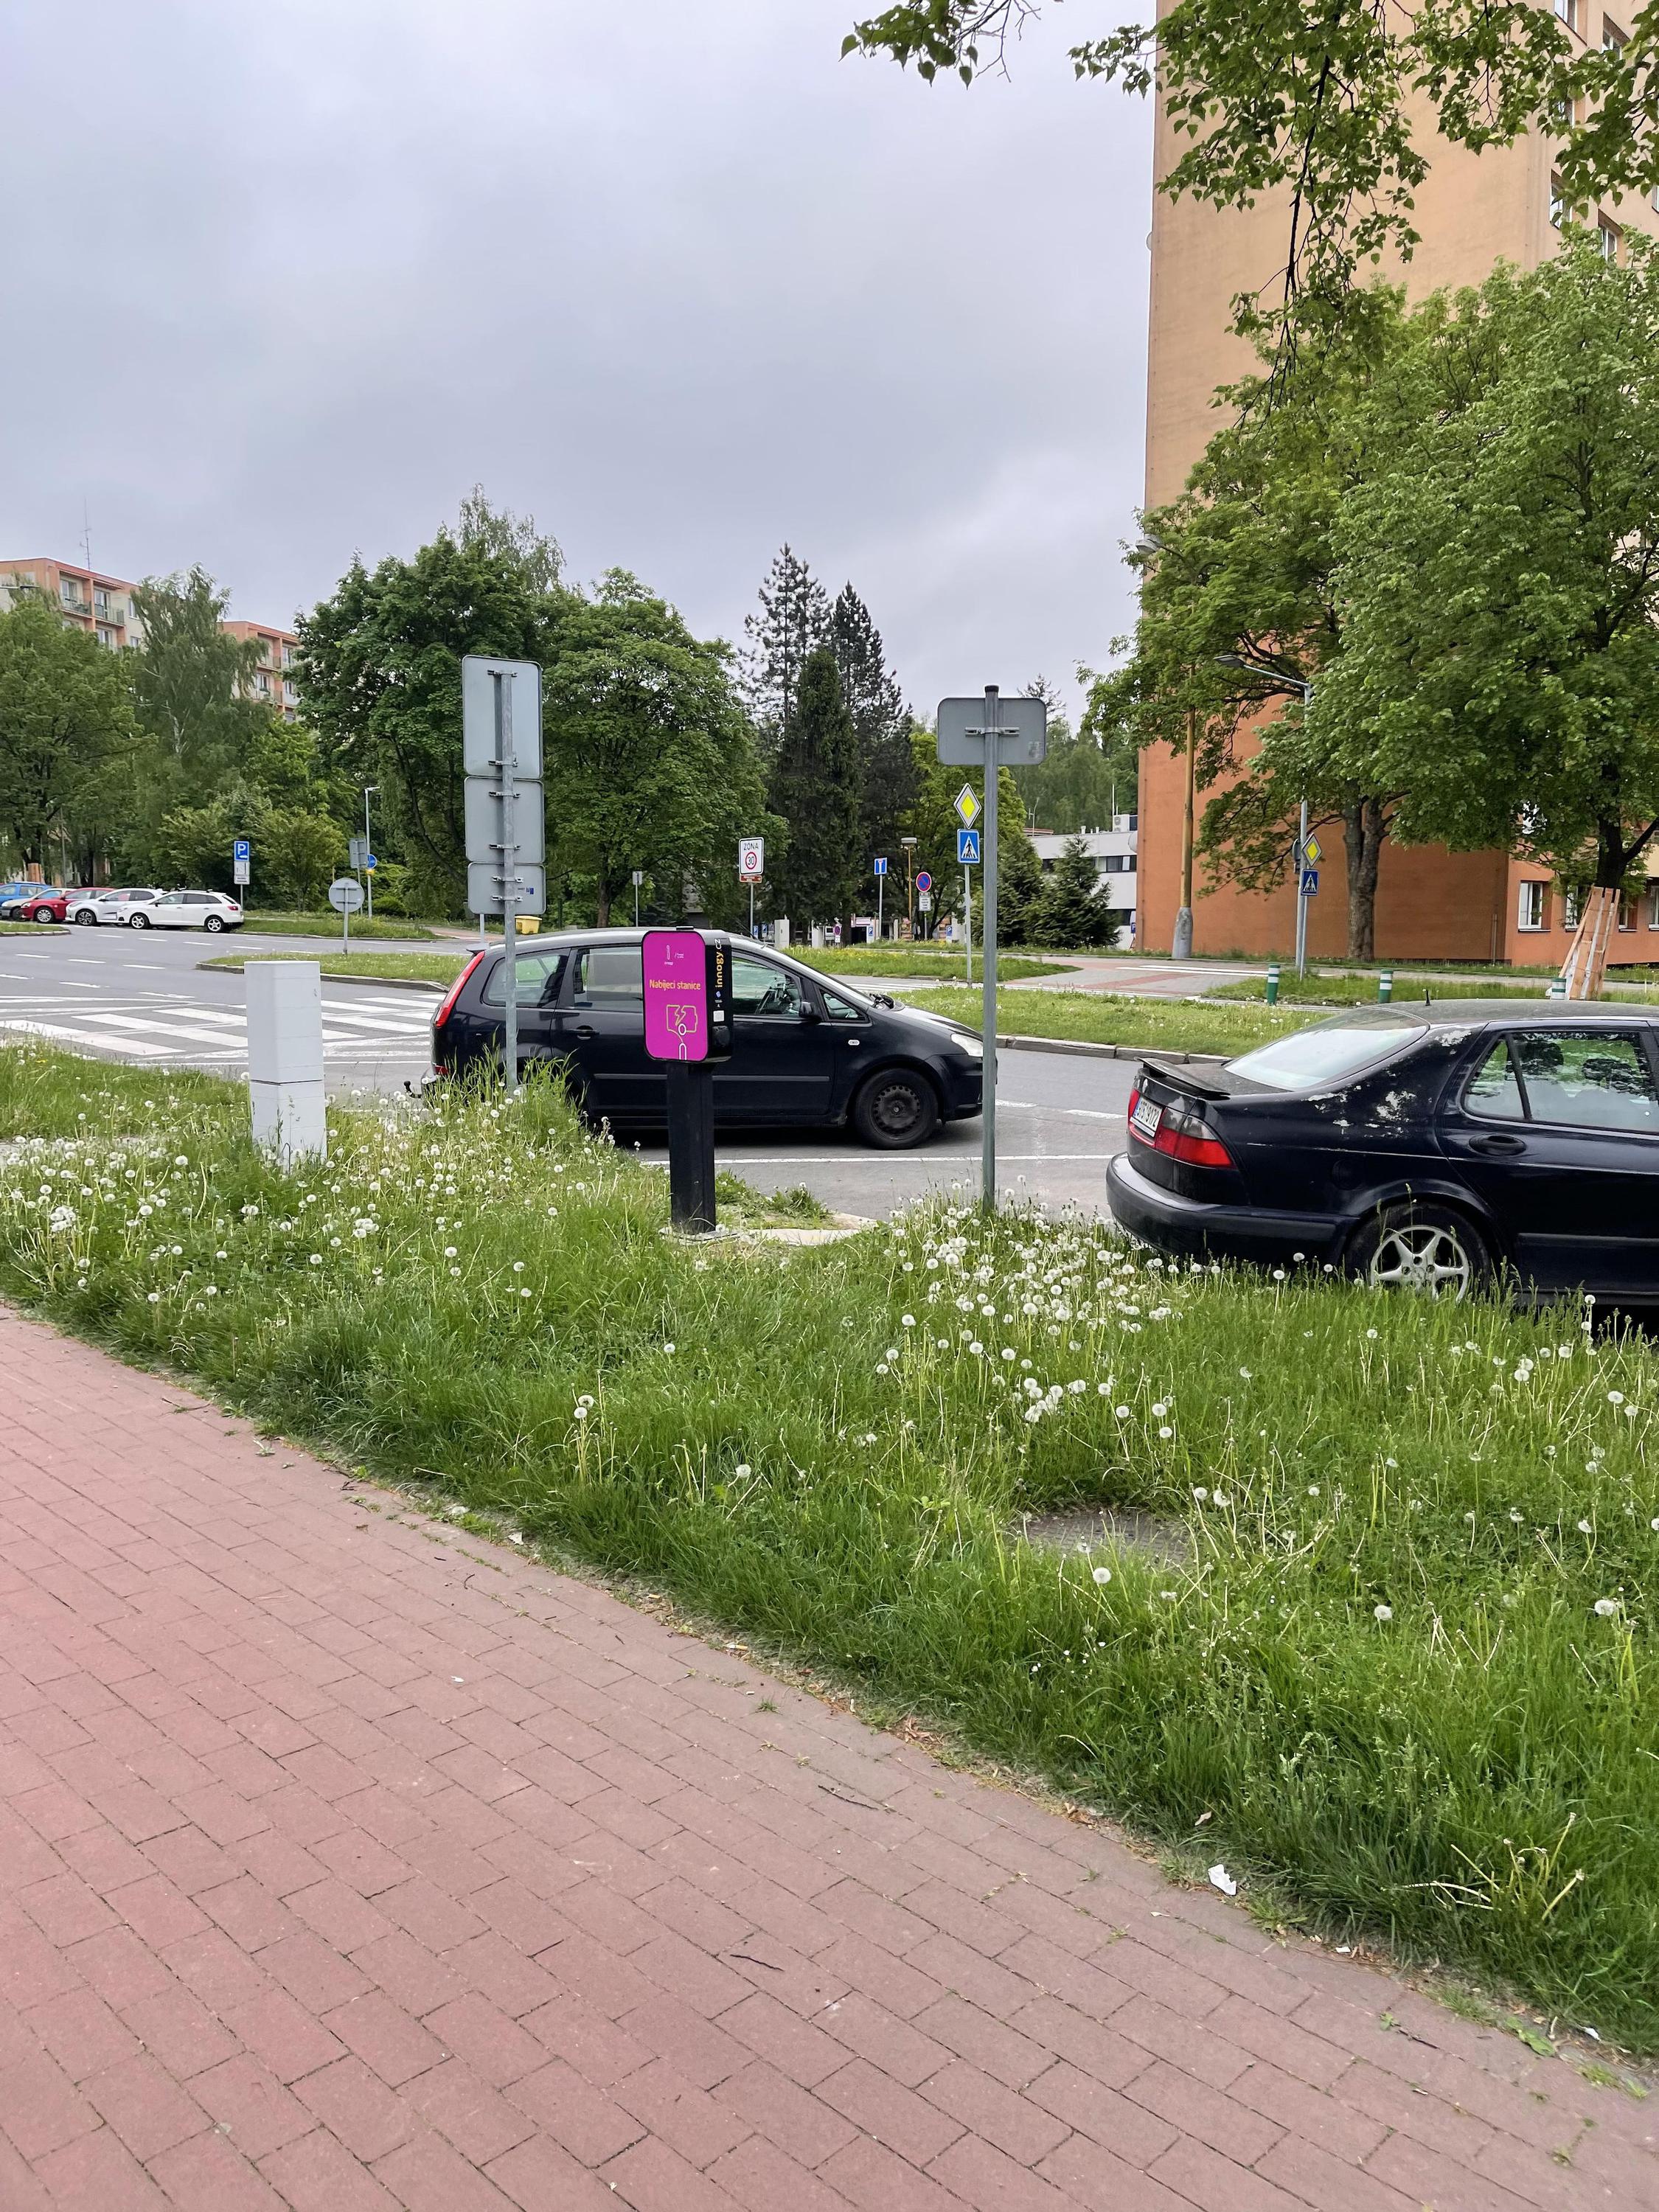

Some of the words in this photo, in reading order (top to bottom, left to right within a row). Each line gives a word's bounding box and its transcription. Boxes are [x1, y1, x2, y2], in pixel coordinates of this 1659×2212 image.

[237, 844, 246, 855] P
[743, 843, 759, 851] ZONA
[747, 856, 754, 866] 30
[677, 981, 701, 990] stanice
